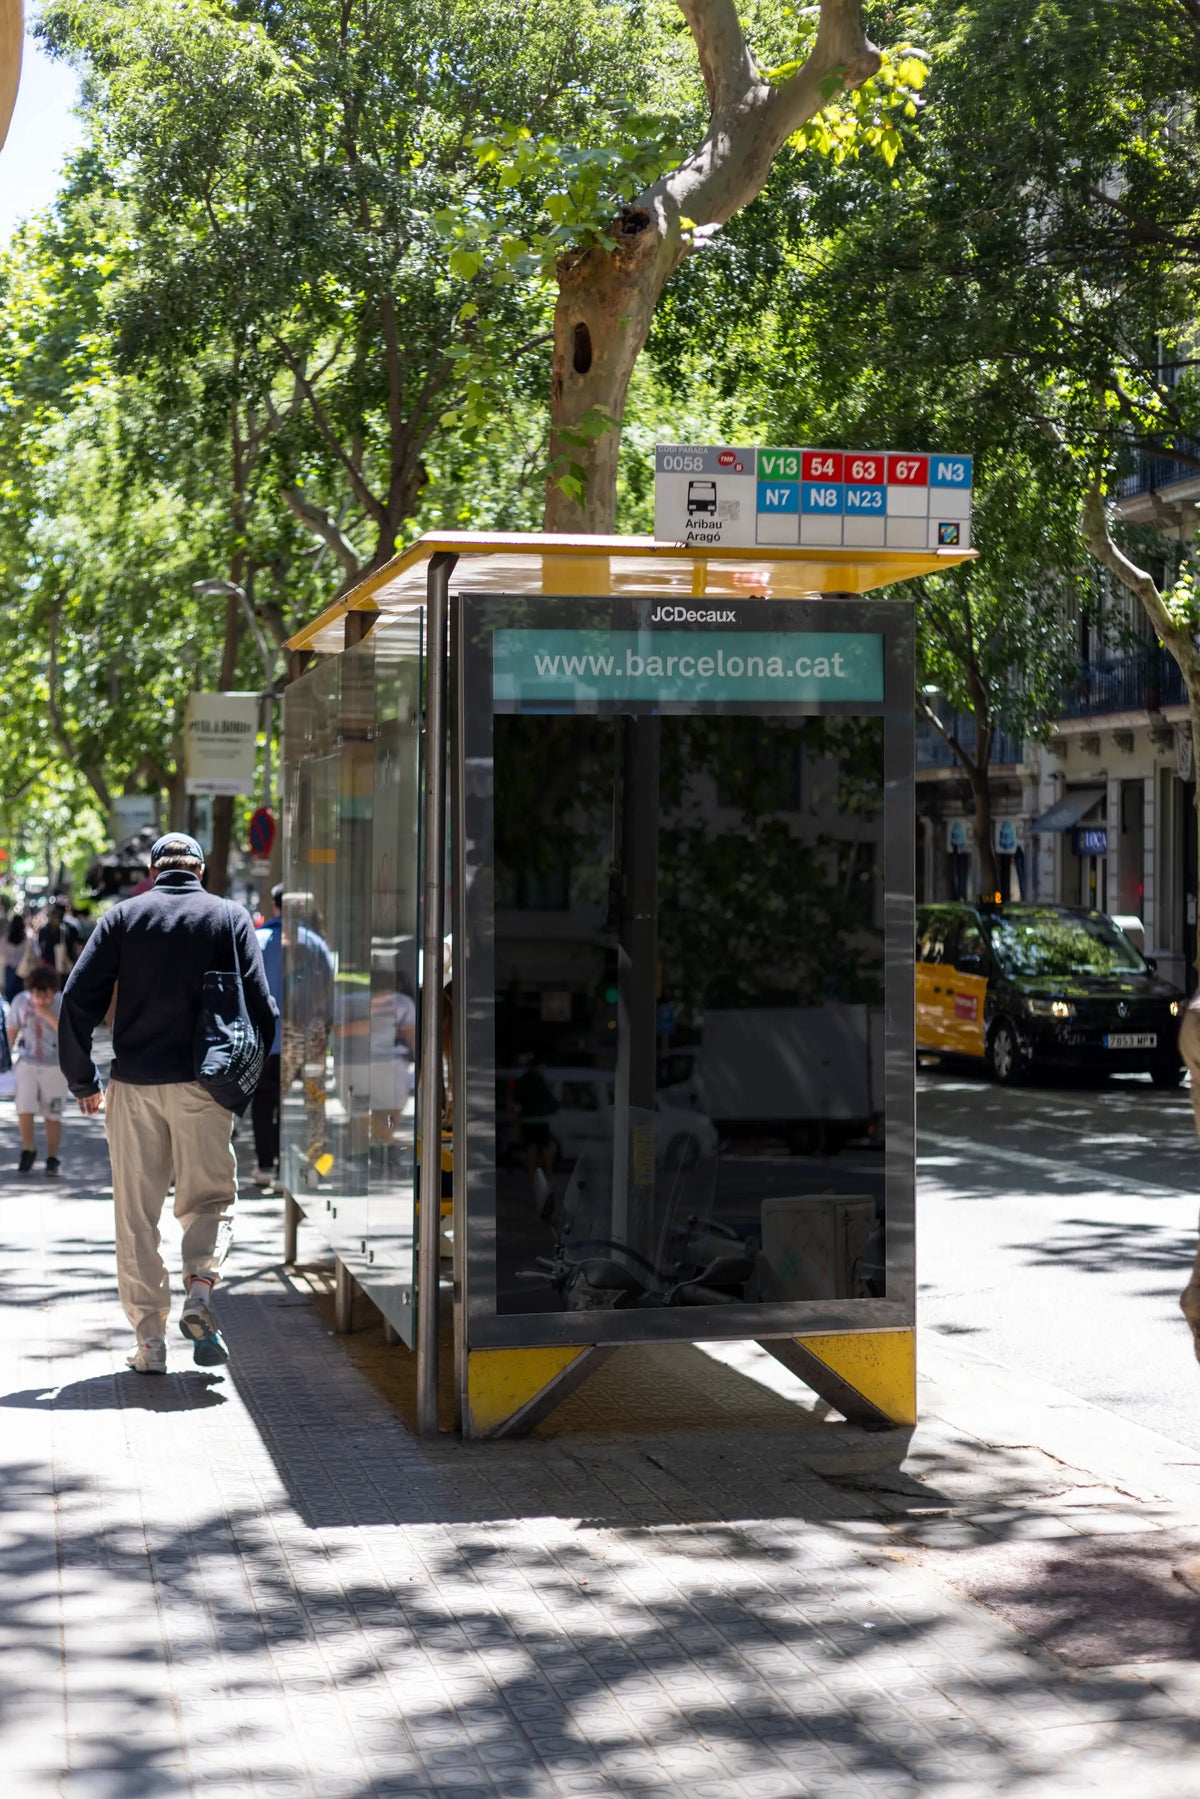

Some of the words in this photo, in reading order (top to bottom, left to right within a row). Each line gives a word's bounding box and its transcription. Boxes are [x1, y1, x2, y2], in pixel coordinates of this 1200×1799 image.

[663, 456, 703, 471] 0058
[762, 456, 797, 475] V13
[811, 457, 835, 476] 54
[852, 461, 876, 480] 63
[896, 461, 920, 479] 67
[938, 462, 964, 481] N3
[766, 489, 790, 506] N7
[810, 488, 837, 507] N8
[847, 490, 882, 508] N23
[685, 519, 722, 529] Aribau
[687, 531, 721, 543] Aragó
[651, 606, 736, 622] JCDecaux
[534, 649, 845, 678] www.barcelona.cat
